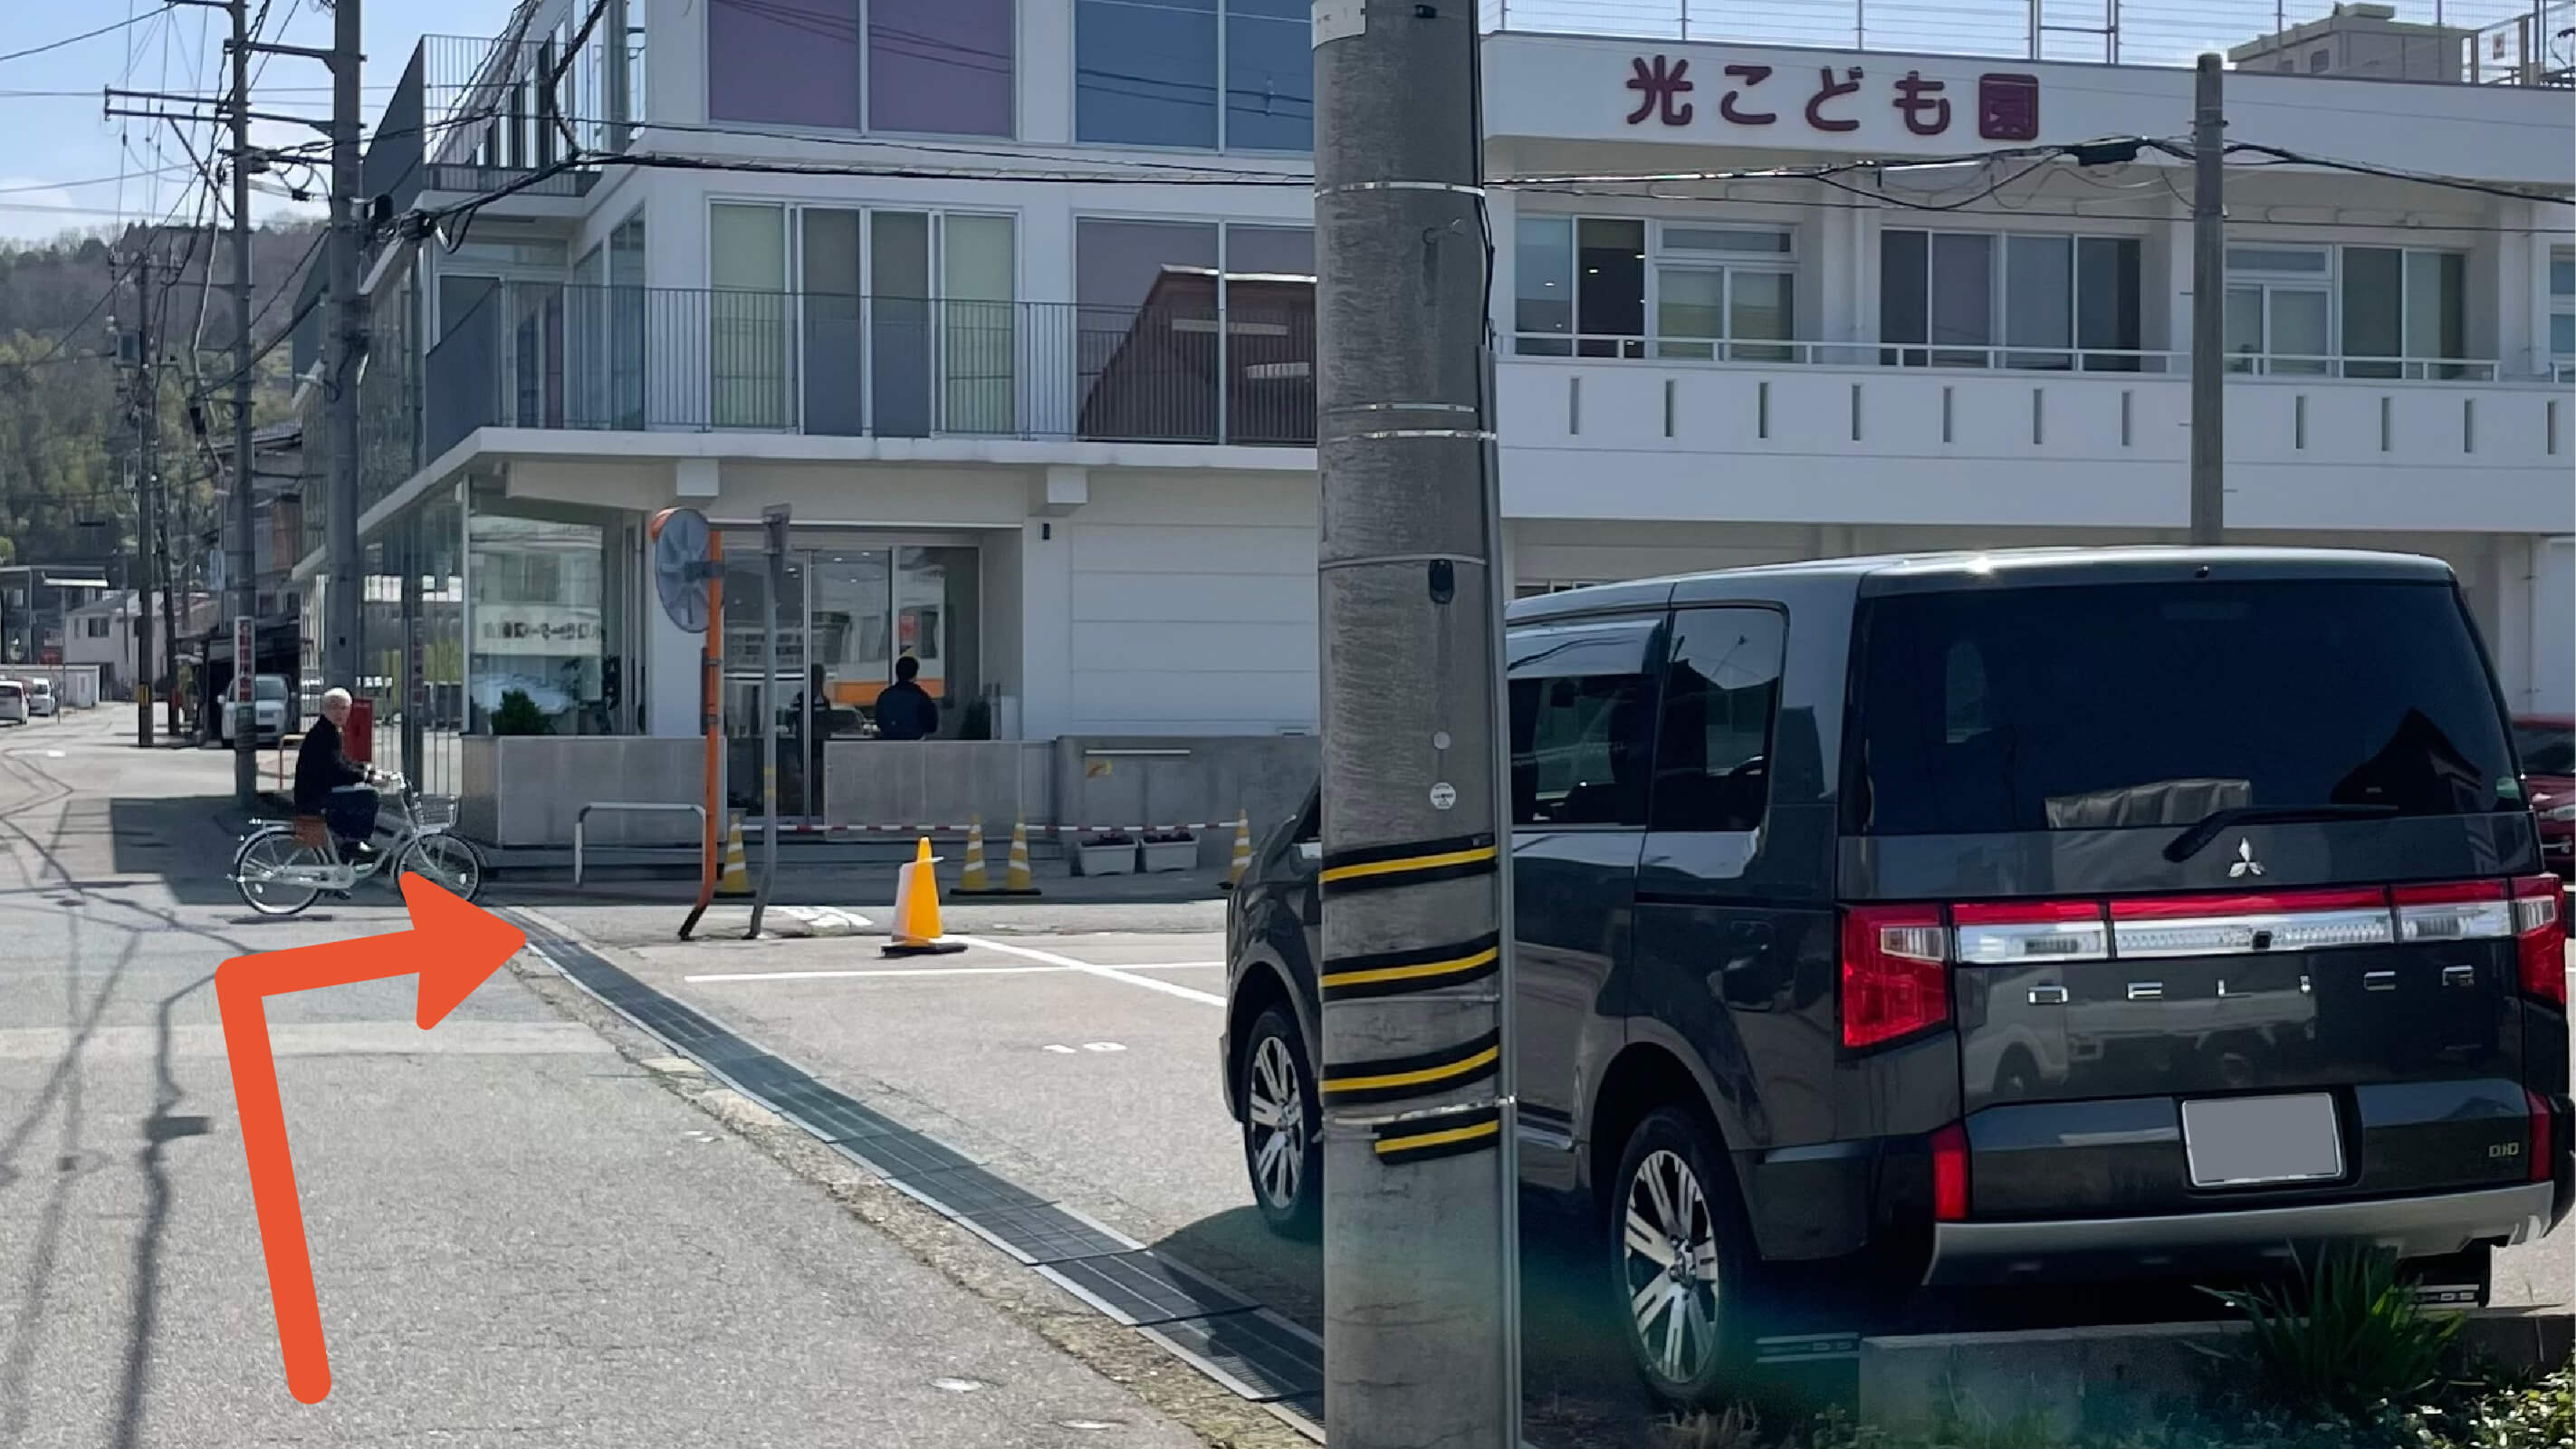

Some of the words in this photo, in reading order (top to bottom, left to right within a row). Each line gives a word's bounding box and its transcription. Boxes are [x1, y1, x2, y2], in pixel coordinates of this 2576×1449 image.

[1626, 54, 2039, 141] 光こども園
